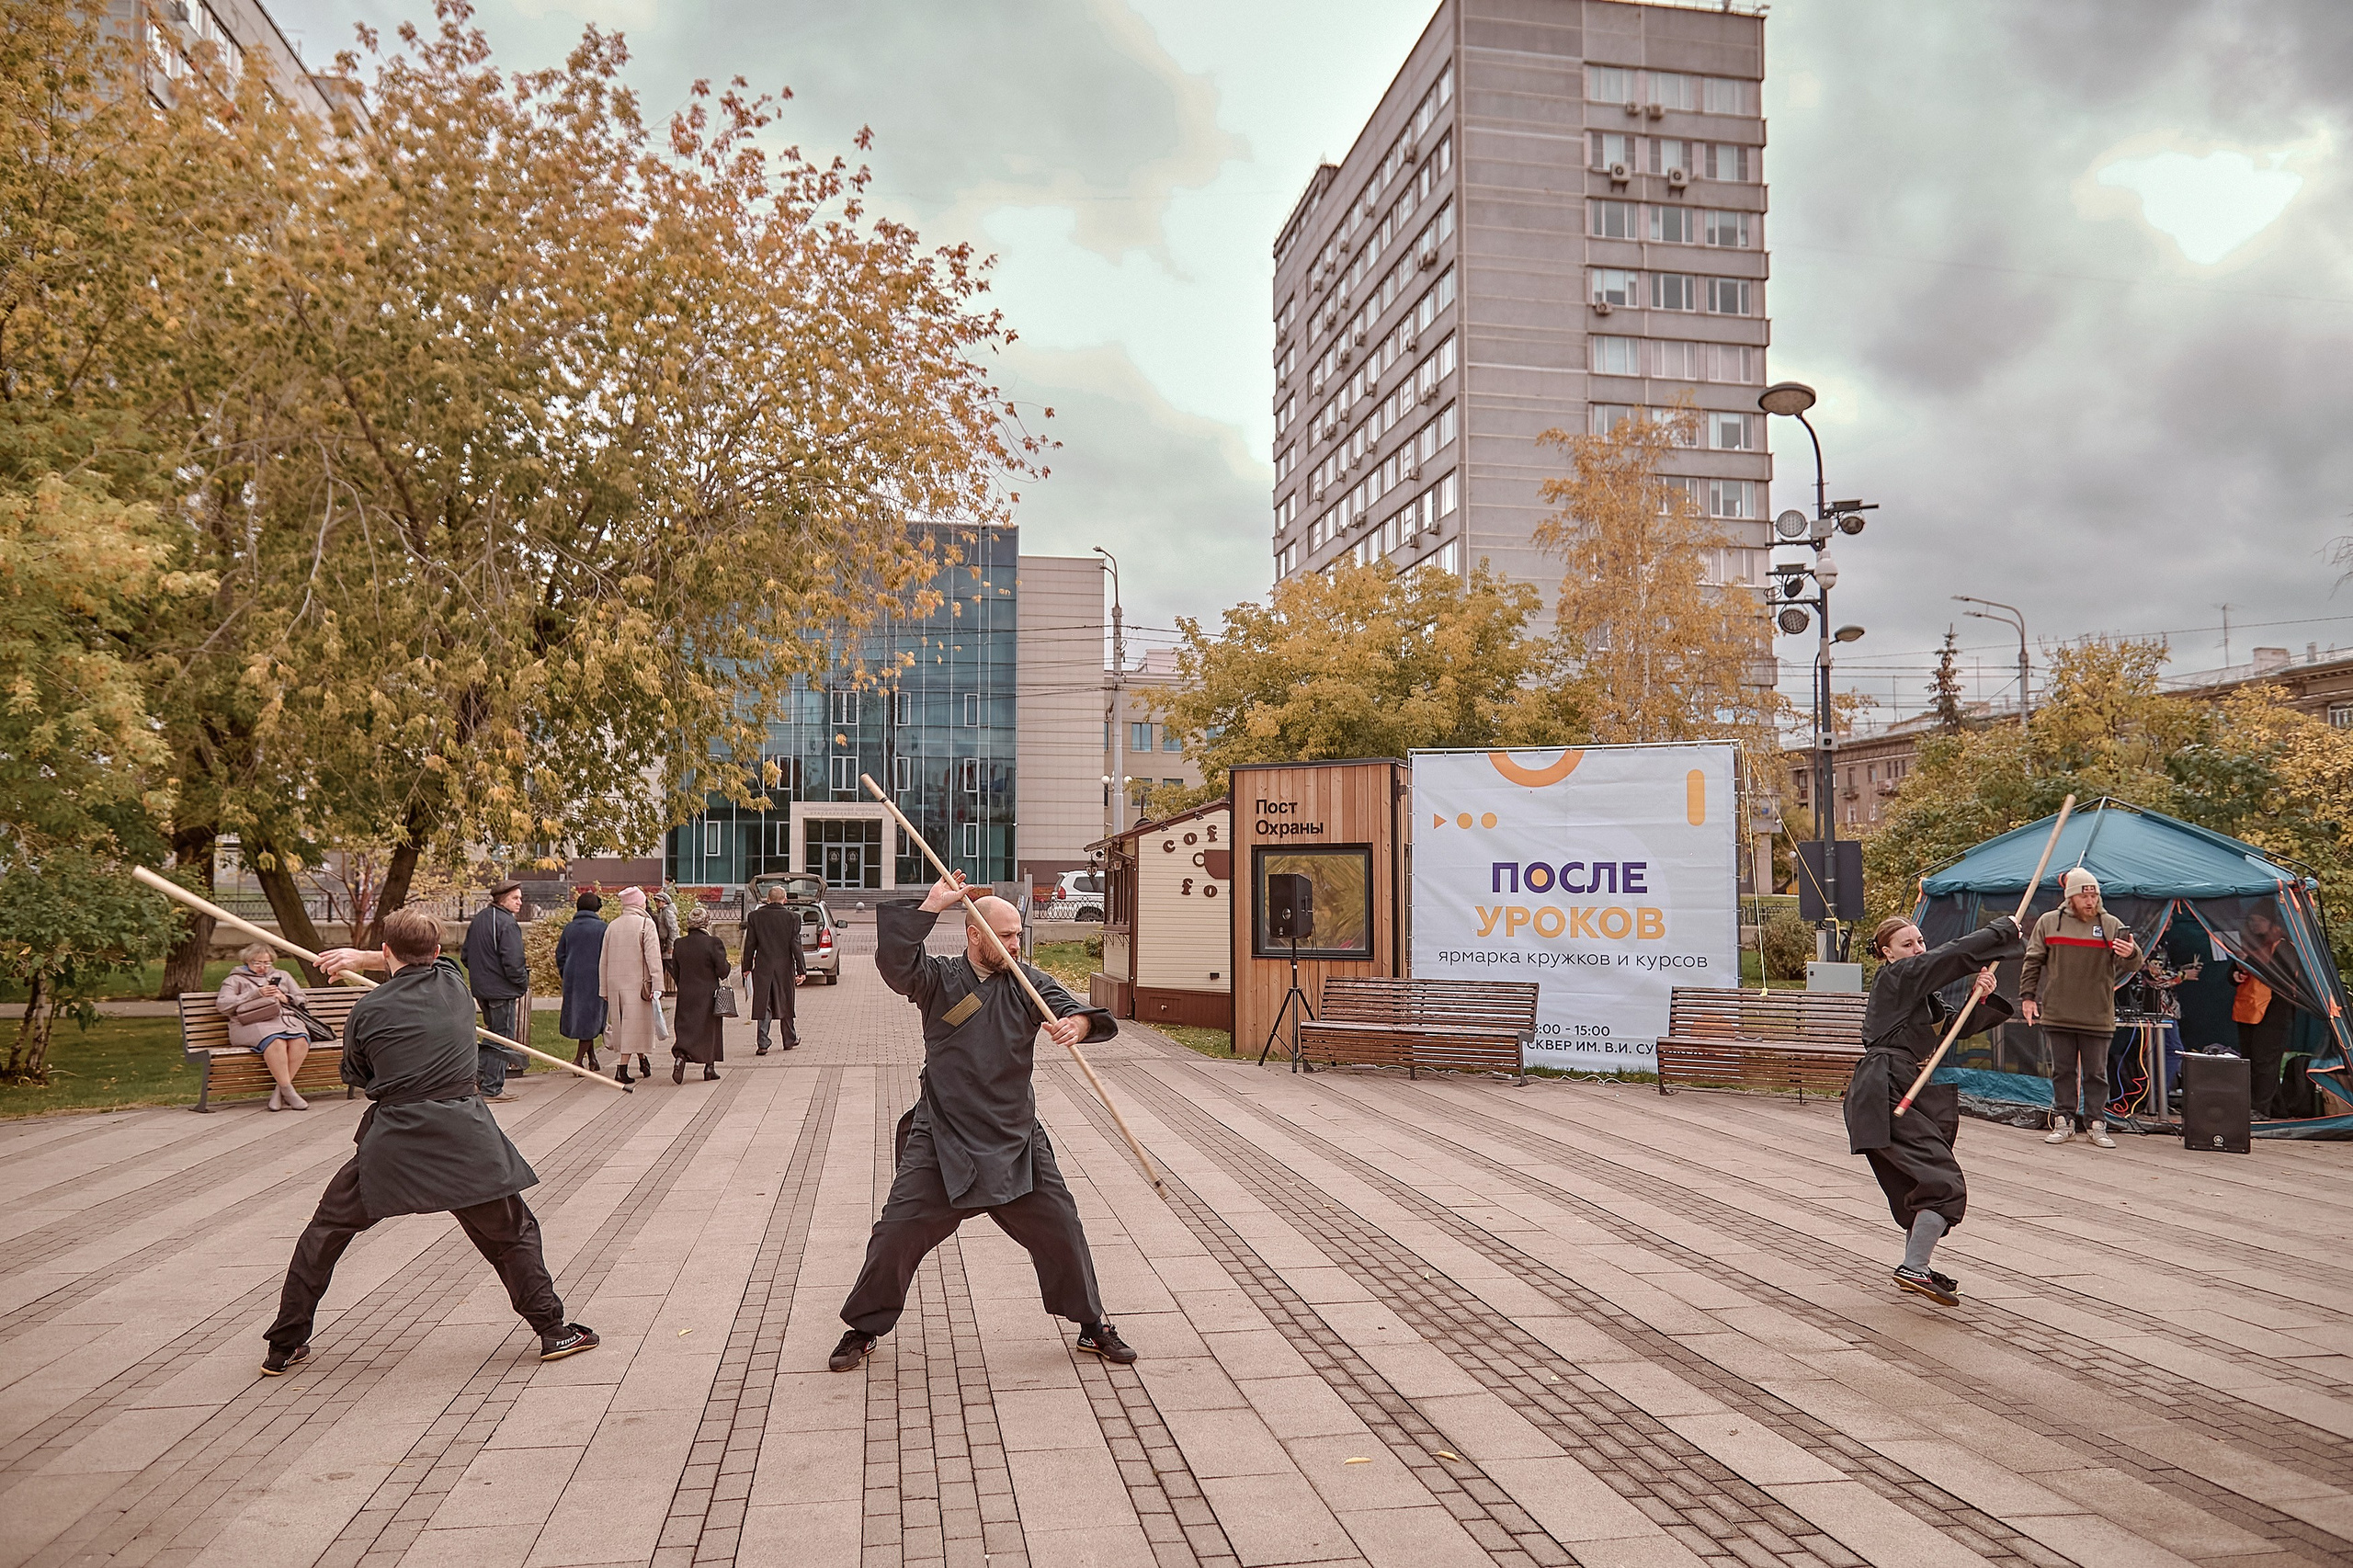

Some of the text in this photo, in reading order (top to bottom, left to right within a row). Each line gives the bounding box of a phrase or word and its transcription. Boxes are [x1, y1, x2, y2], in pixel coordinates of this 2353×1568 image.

[1256, 799, 1298, 814] Пост
[1255, 819, 1324, 838] Охраны
[1492, 861, 1648, 893] ПОСЛЕ
[1474, 905, 1665, 939] УРОКОВ
[1438, 950, 1708, 971] ярмарка кружков и курсов
[1574, 1025, 1610, 1037] 15:00
[1527, 1040, 1657, 1055] СКВЕР ИМ. В.И. СУ
